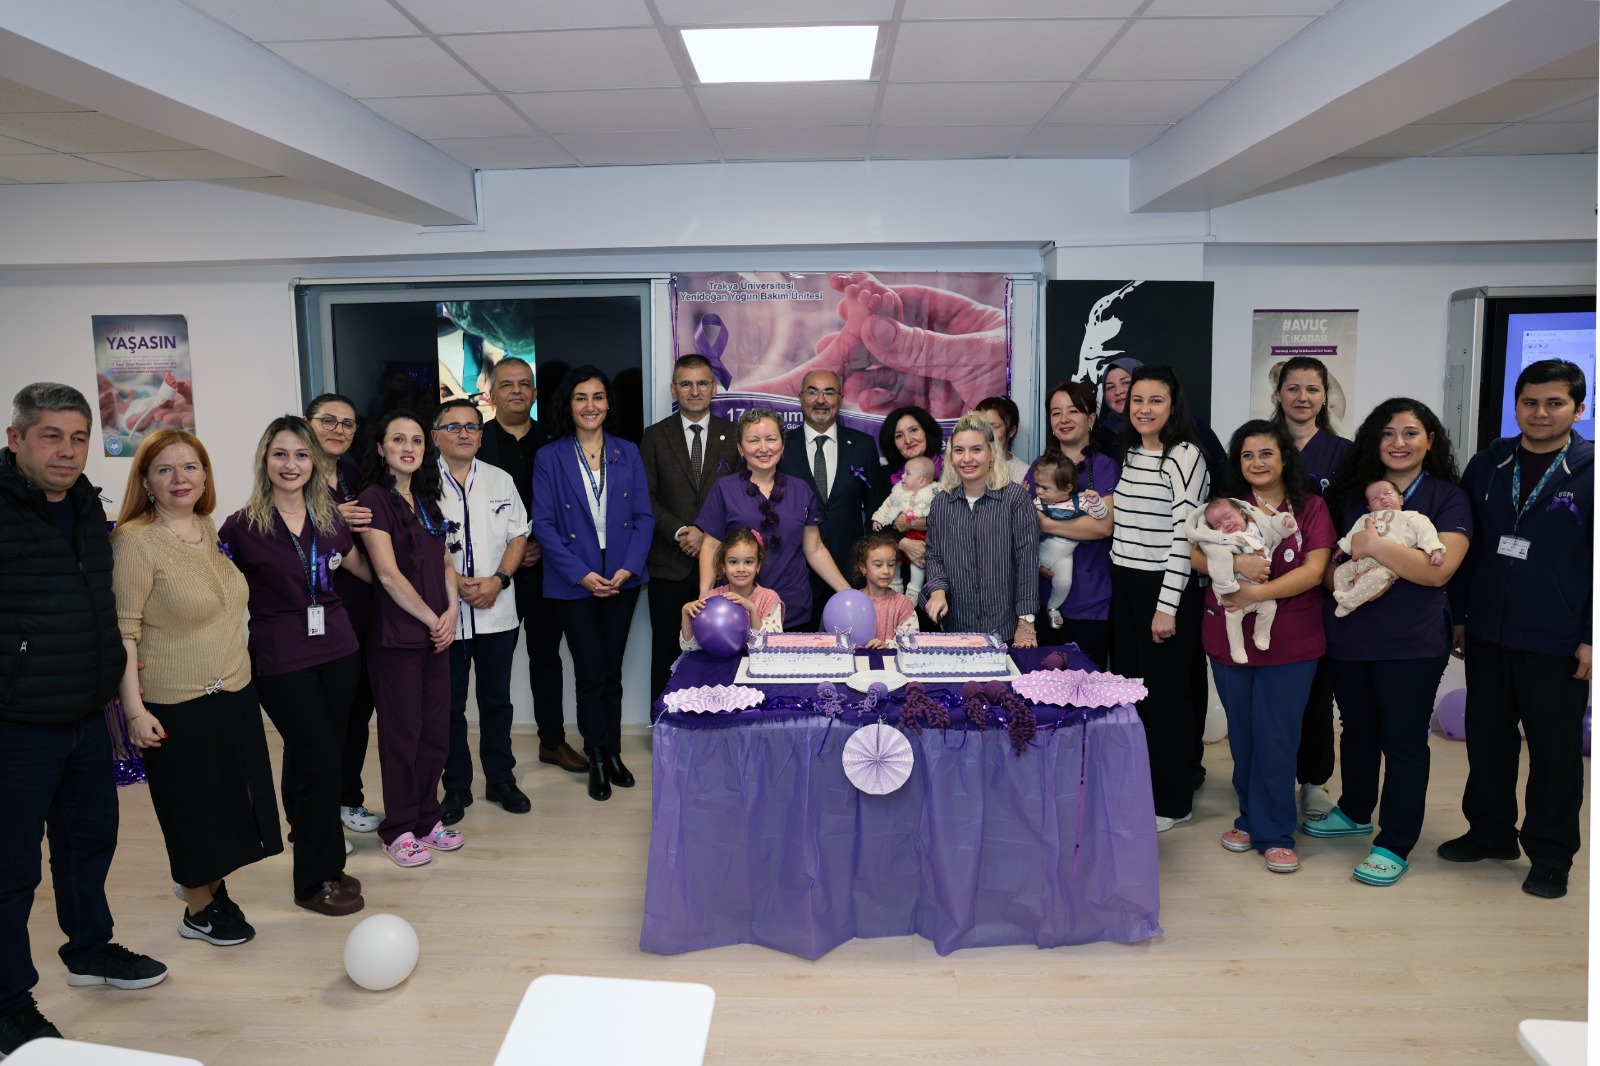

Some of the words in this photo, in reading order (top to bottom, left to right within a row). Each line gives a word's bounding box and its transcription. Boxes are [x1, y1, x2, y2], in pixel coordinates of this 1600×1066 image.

[708, 281, 738, 292] Trakya
[740, 280, 795, 291] Üniversitesi
[679, 291, 728, 303] Yenidoğan
[729, 291, 759, 303] Yoğun
[760, 291, 789, 301] Bakım
[791, 289, 824, 301] Ünitesi
[1282, 318, 1328, 334] #AVUÇ
[105, 335, 177, 354] YAŞASIN
